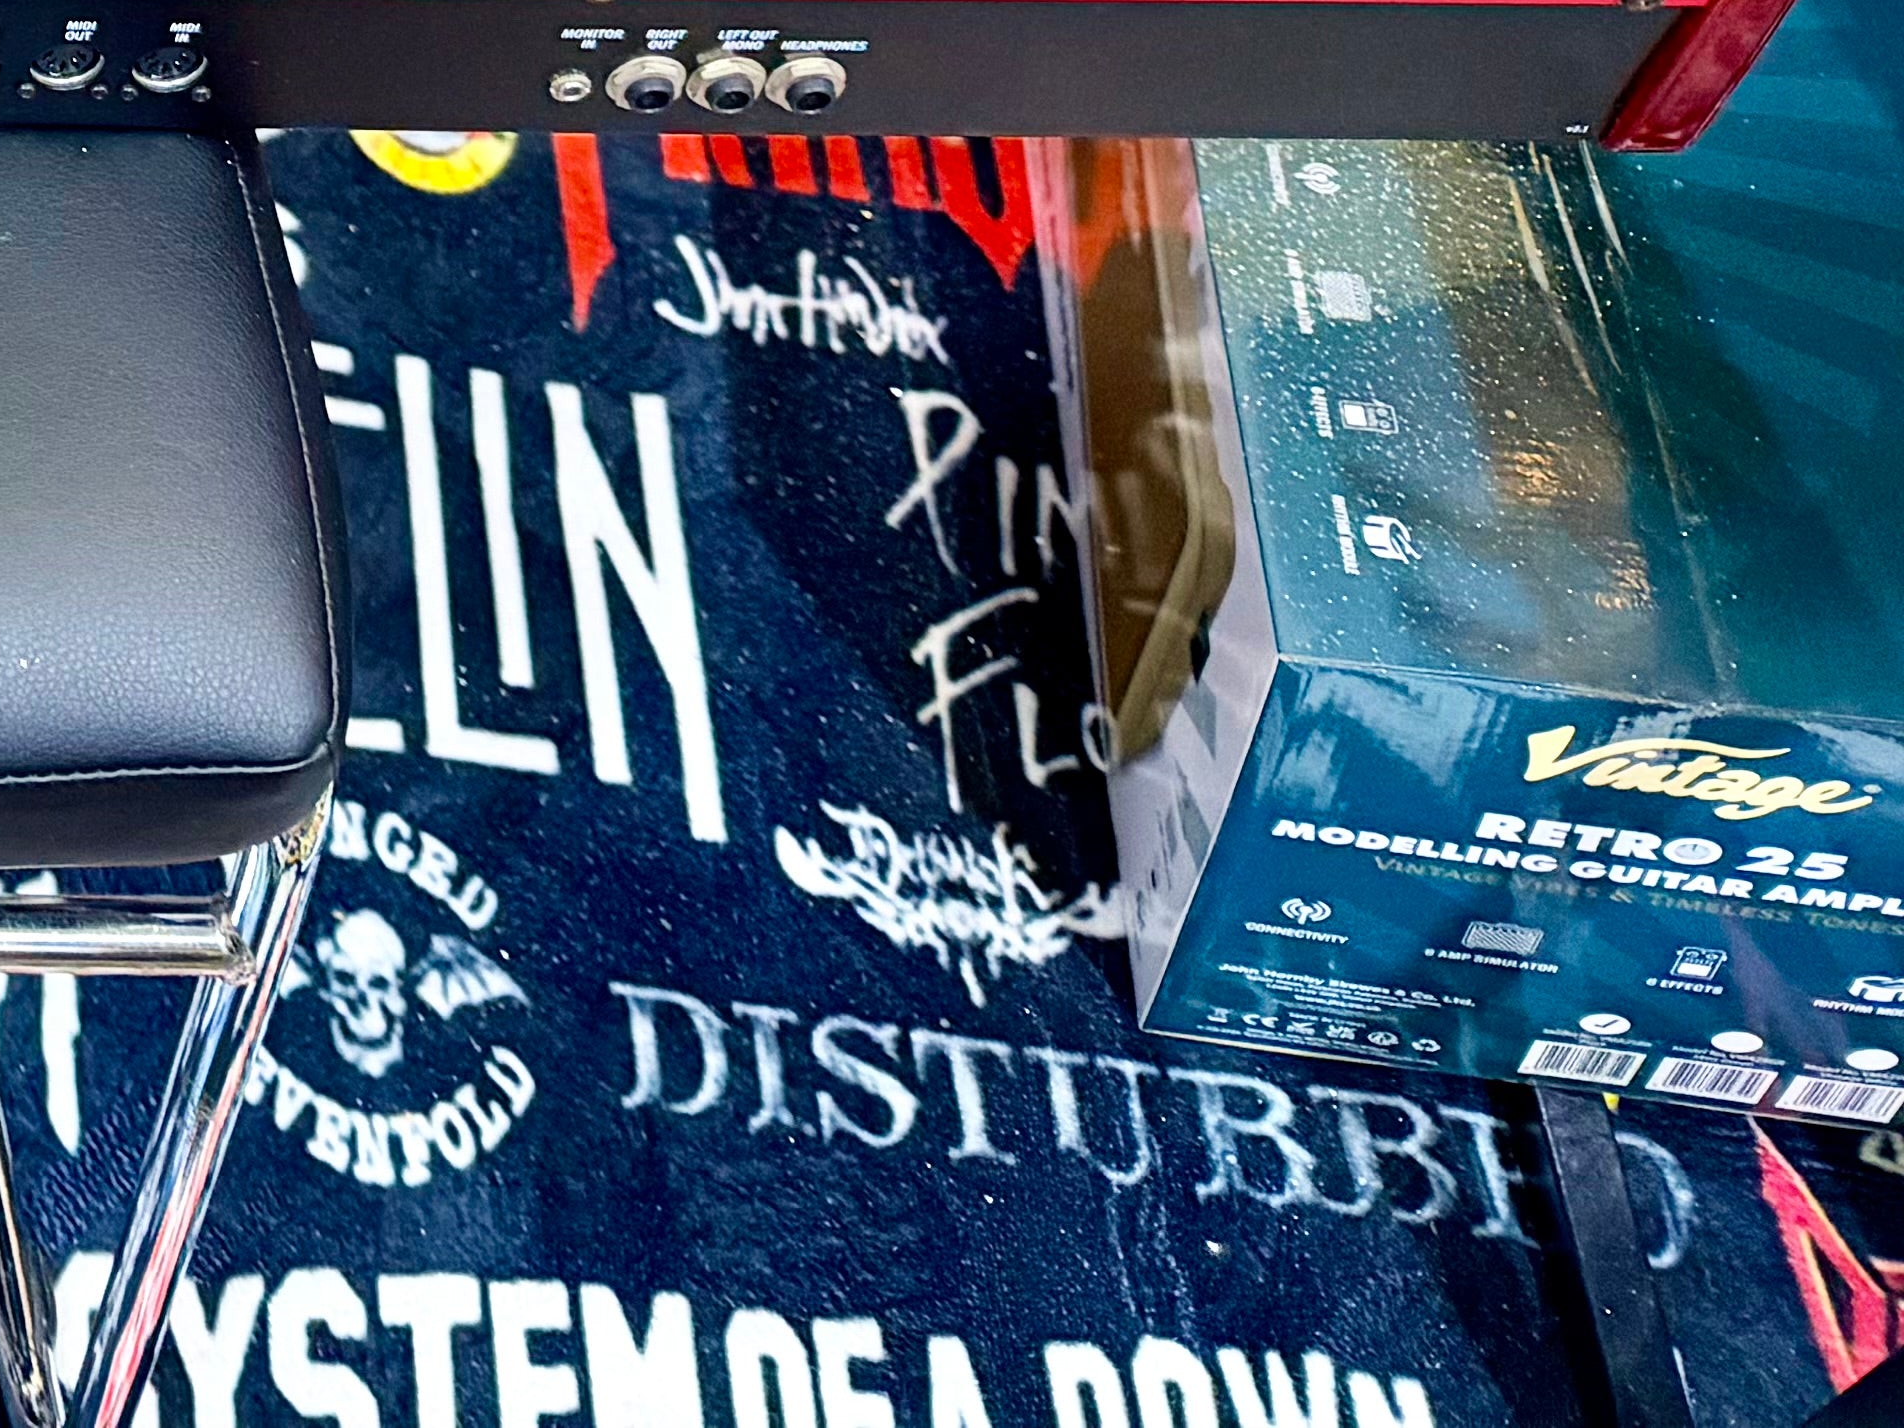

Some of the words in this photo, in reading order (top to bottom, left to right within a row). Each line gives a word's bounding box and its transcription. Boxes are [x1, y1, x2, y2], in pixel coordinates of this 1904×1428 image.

[66, 20, 98, 31] MIDI
[169, 22, 201, 34] MIDI
[64, 31, 92, 42] OUT
[175, 33, 190, 44] IN
[560, 28, 625, 39] MONITOR
[645, 29, 688, 40] RIGHT
[717, 29, 749, 40] LEFT
[750, 30, 779, 40] OUT
[647, 39, 677, 50] OUT
[722, 40, 765, 51] MONO
[780, 40, 869, 52] HEADPHONES
[1524, 725, 1878, 821] Vintage
[1475, 812, 1724, 866] RETRO
[1735, 846, 1848, 882] 25
[329, 799, 499, 931] NGED
[1271, 819, 1561, 875] MODELLING
[1568, 858, 1756, 900] GUITAR
[1761, 883, 1904, 918] AMPL
[1245, 921, 1348, 944] CONNECTIVITY
[1438, 950, 1472, 962] AMP
[1473, 954, 1558, 974] SIMULATOR
[247, 1044, 536, 1189] EVENFOLD
